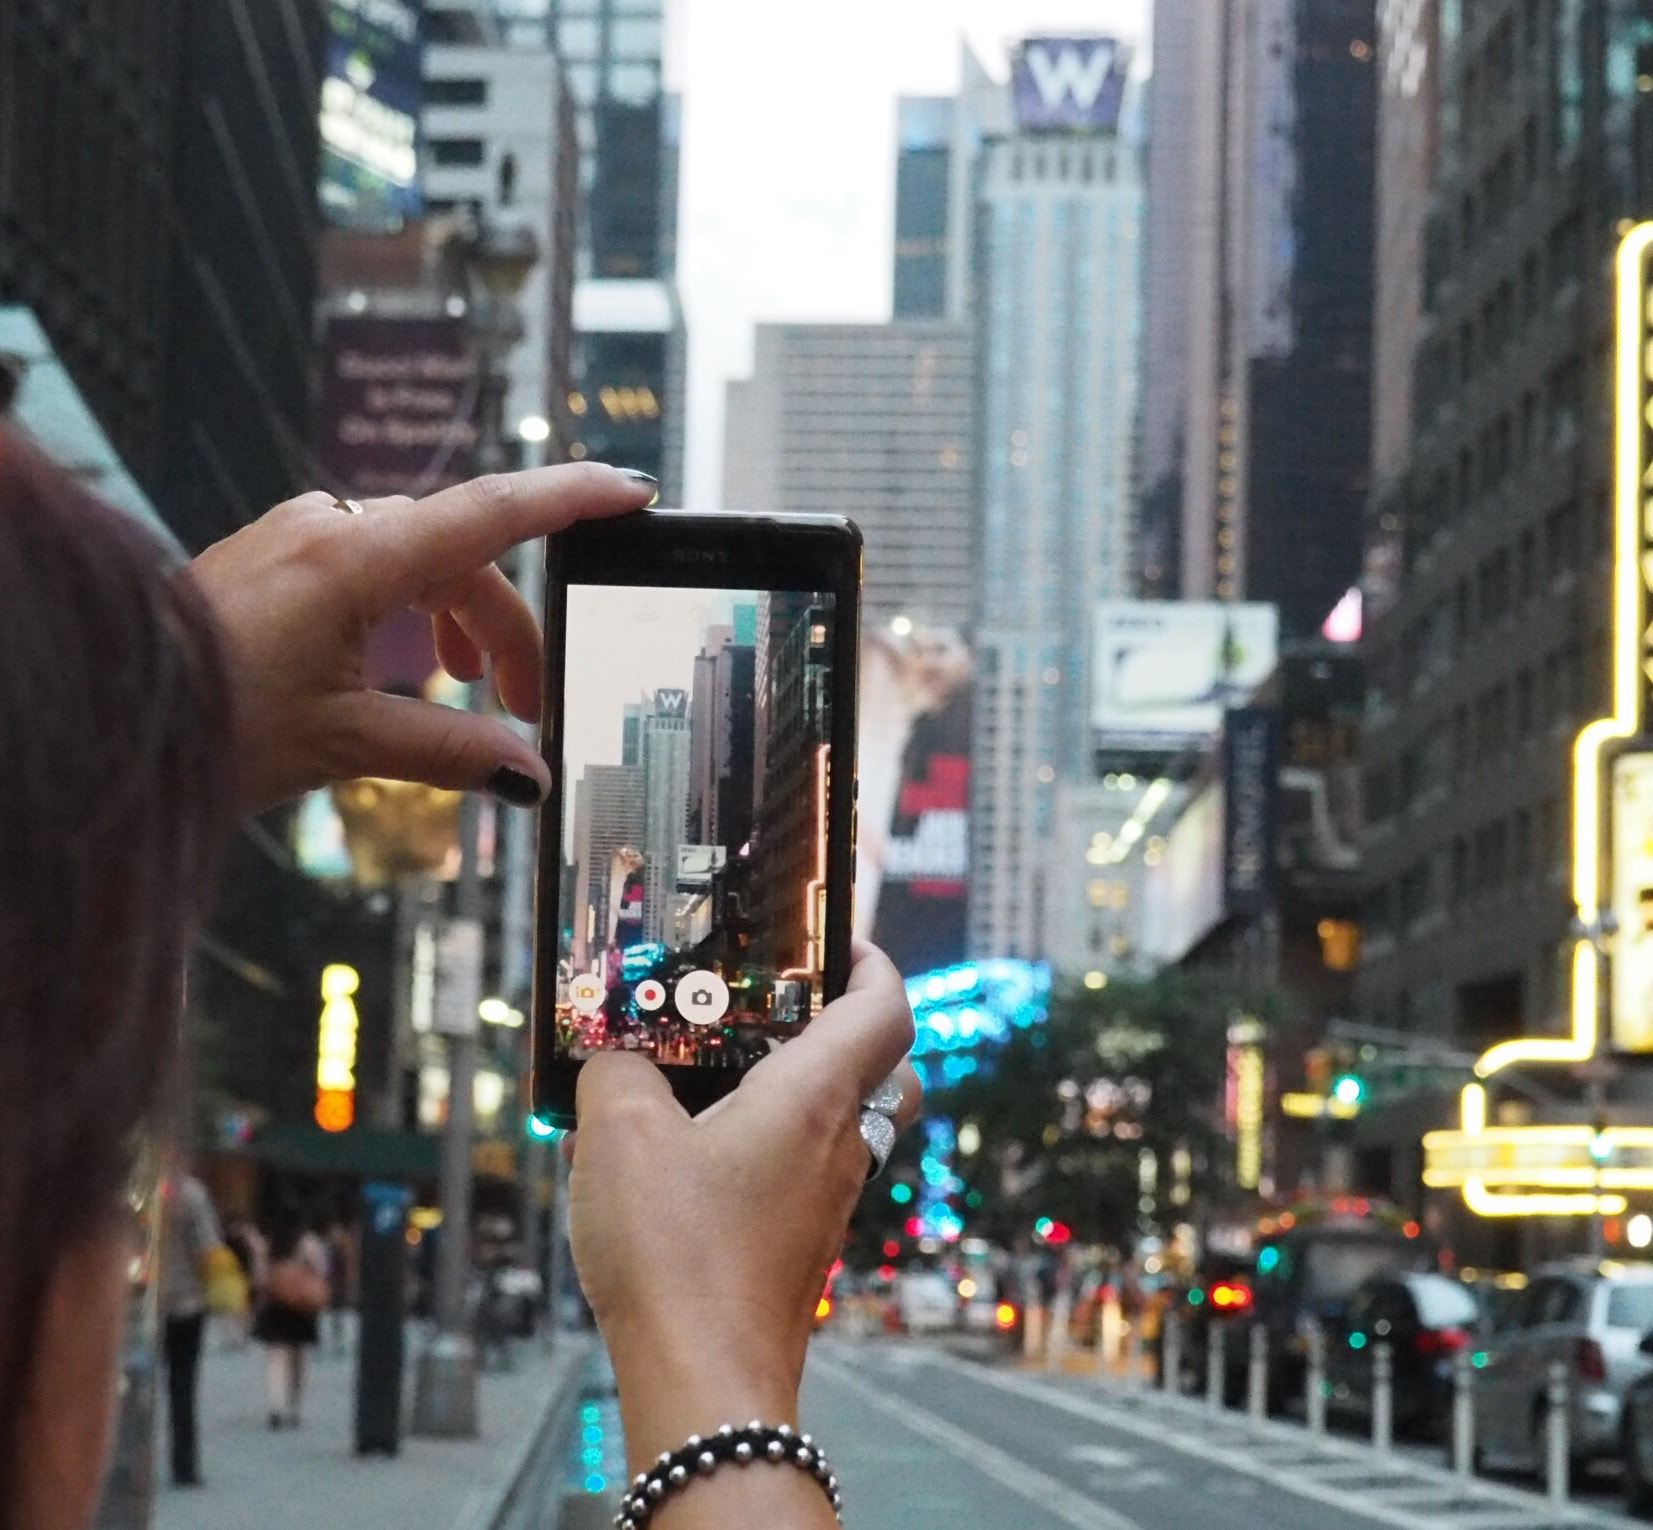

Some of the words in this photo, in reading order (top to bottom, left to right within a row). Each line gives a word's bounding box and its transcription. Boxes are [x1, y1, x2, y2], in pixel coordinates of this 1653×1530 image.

[1026, 44, 1111, 109] W
[671, 549, 728, 561] SONY
[660, 692, 683, 709] W
